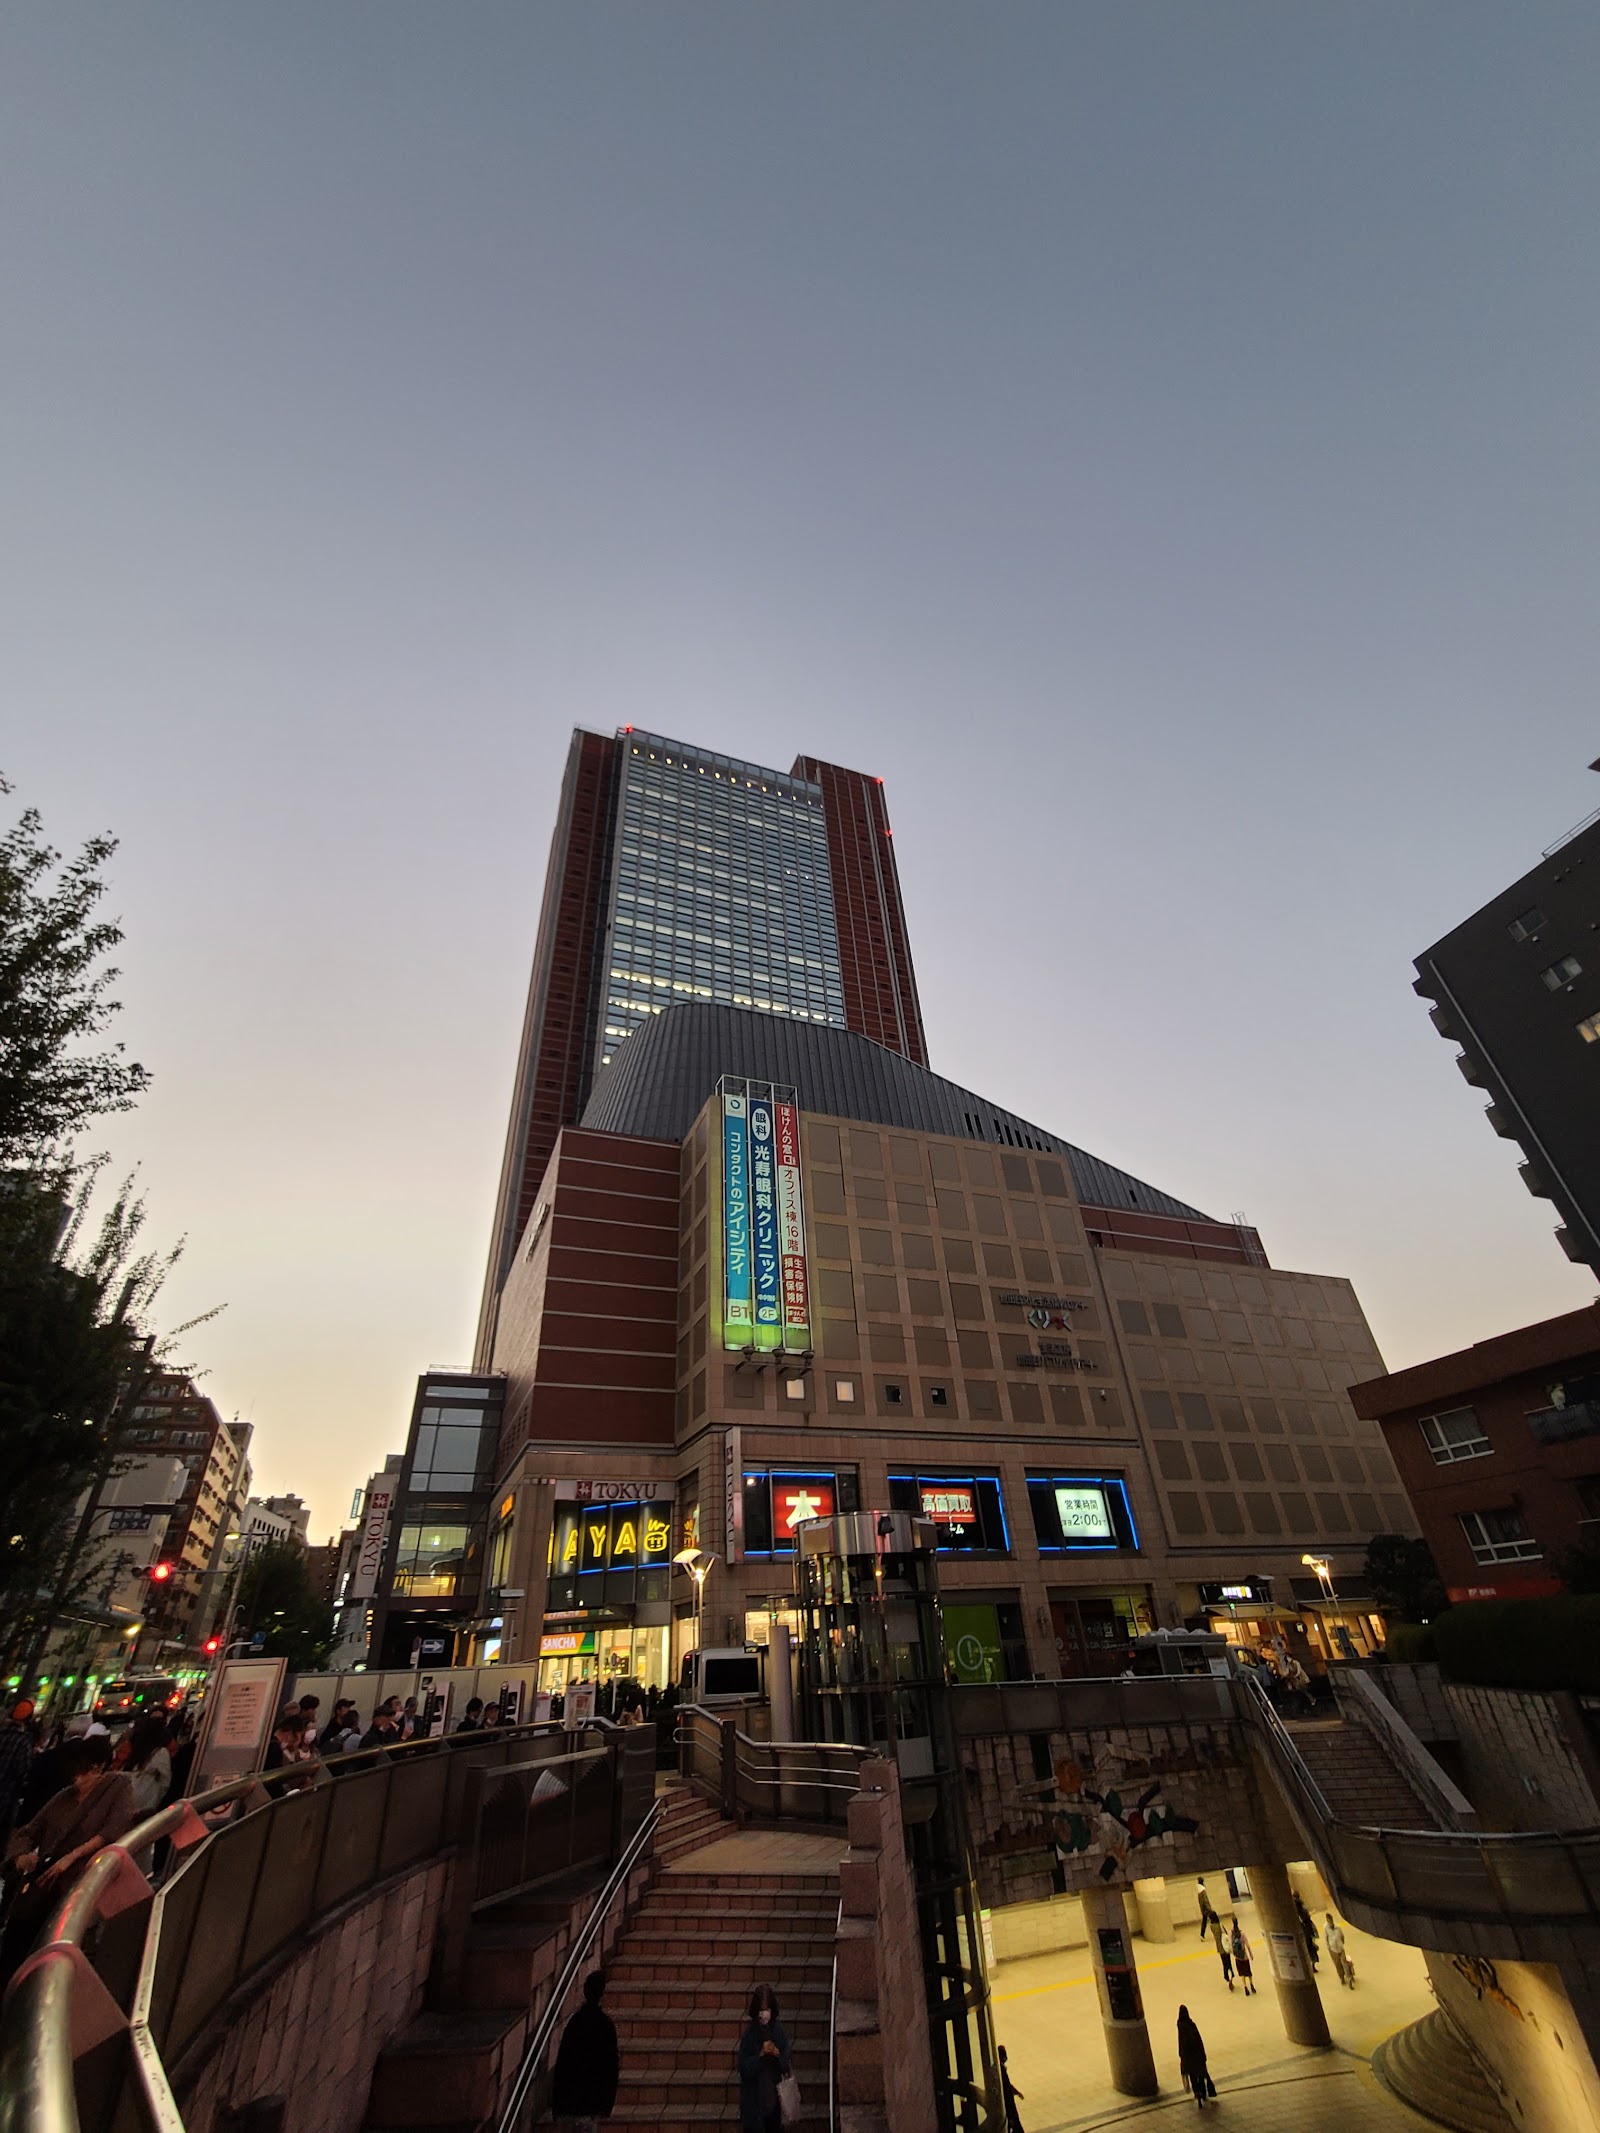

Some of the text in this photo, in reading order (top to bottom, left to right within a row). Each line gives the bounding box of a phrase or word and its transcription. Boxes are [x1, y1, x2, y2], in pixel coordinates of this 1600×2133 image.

[755, 1112, 767, 1136] 眼科
[781, 1107, 793, 1165] ほけんの窓口
[729, 1131, 746, 1275] コンタクトのアイシティ
[755, 1145, 775, 1289] 光寿眼科クリニック
[731, 1306, 748, 1318] B1
[761, 1309, 775, 1319] 2F
[594, 1482, 658, 1499] TOKYU
[921, 1494, 972, 1513] 高価買取
[1064, 1499, 1098, 1510] 営業時間
[361, 1511, 385, 1576] TOKYU
[541, 1636, 577, 1650] SANCHA
